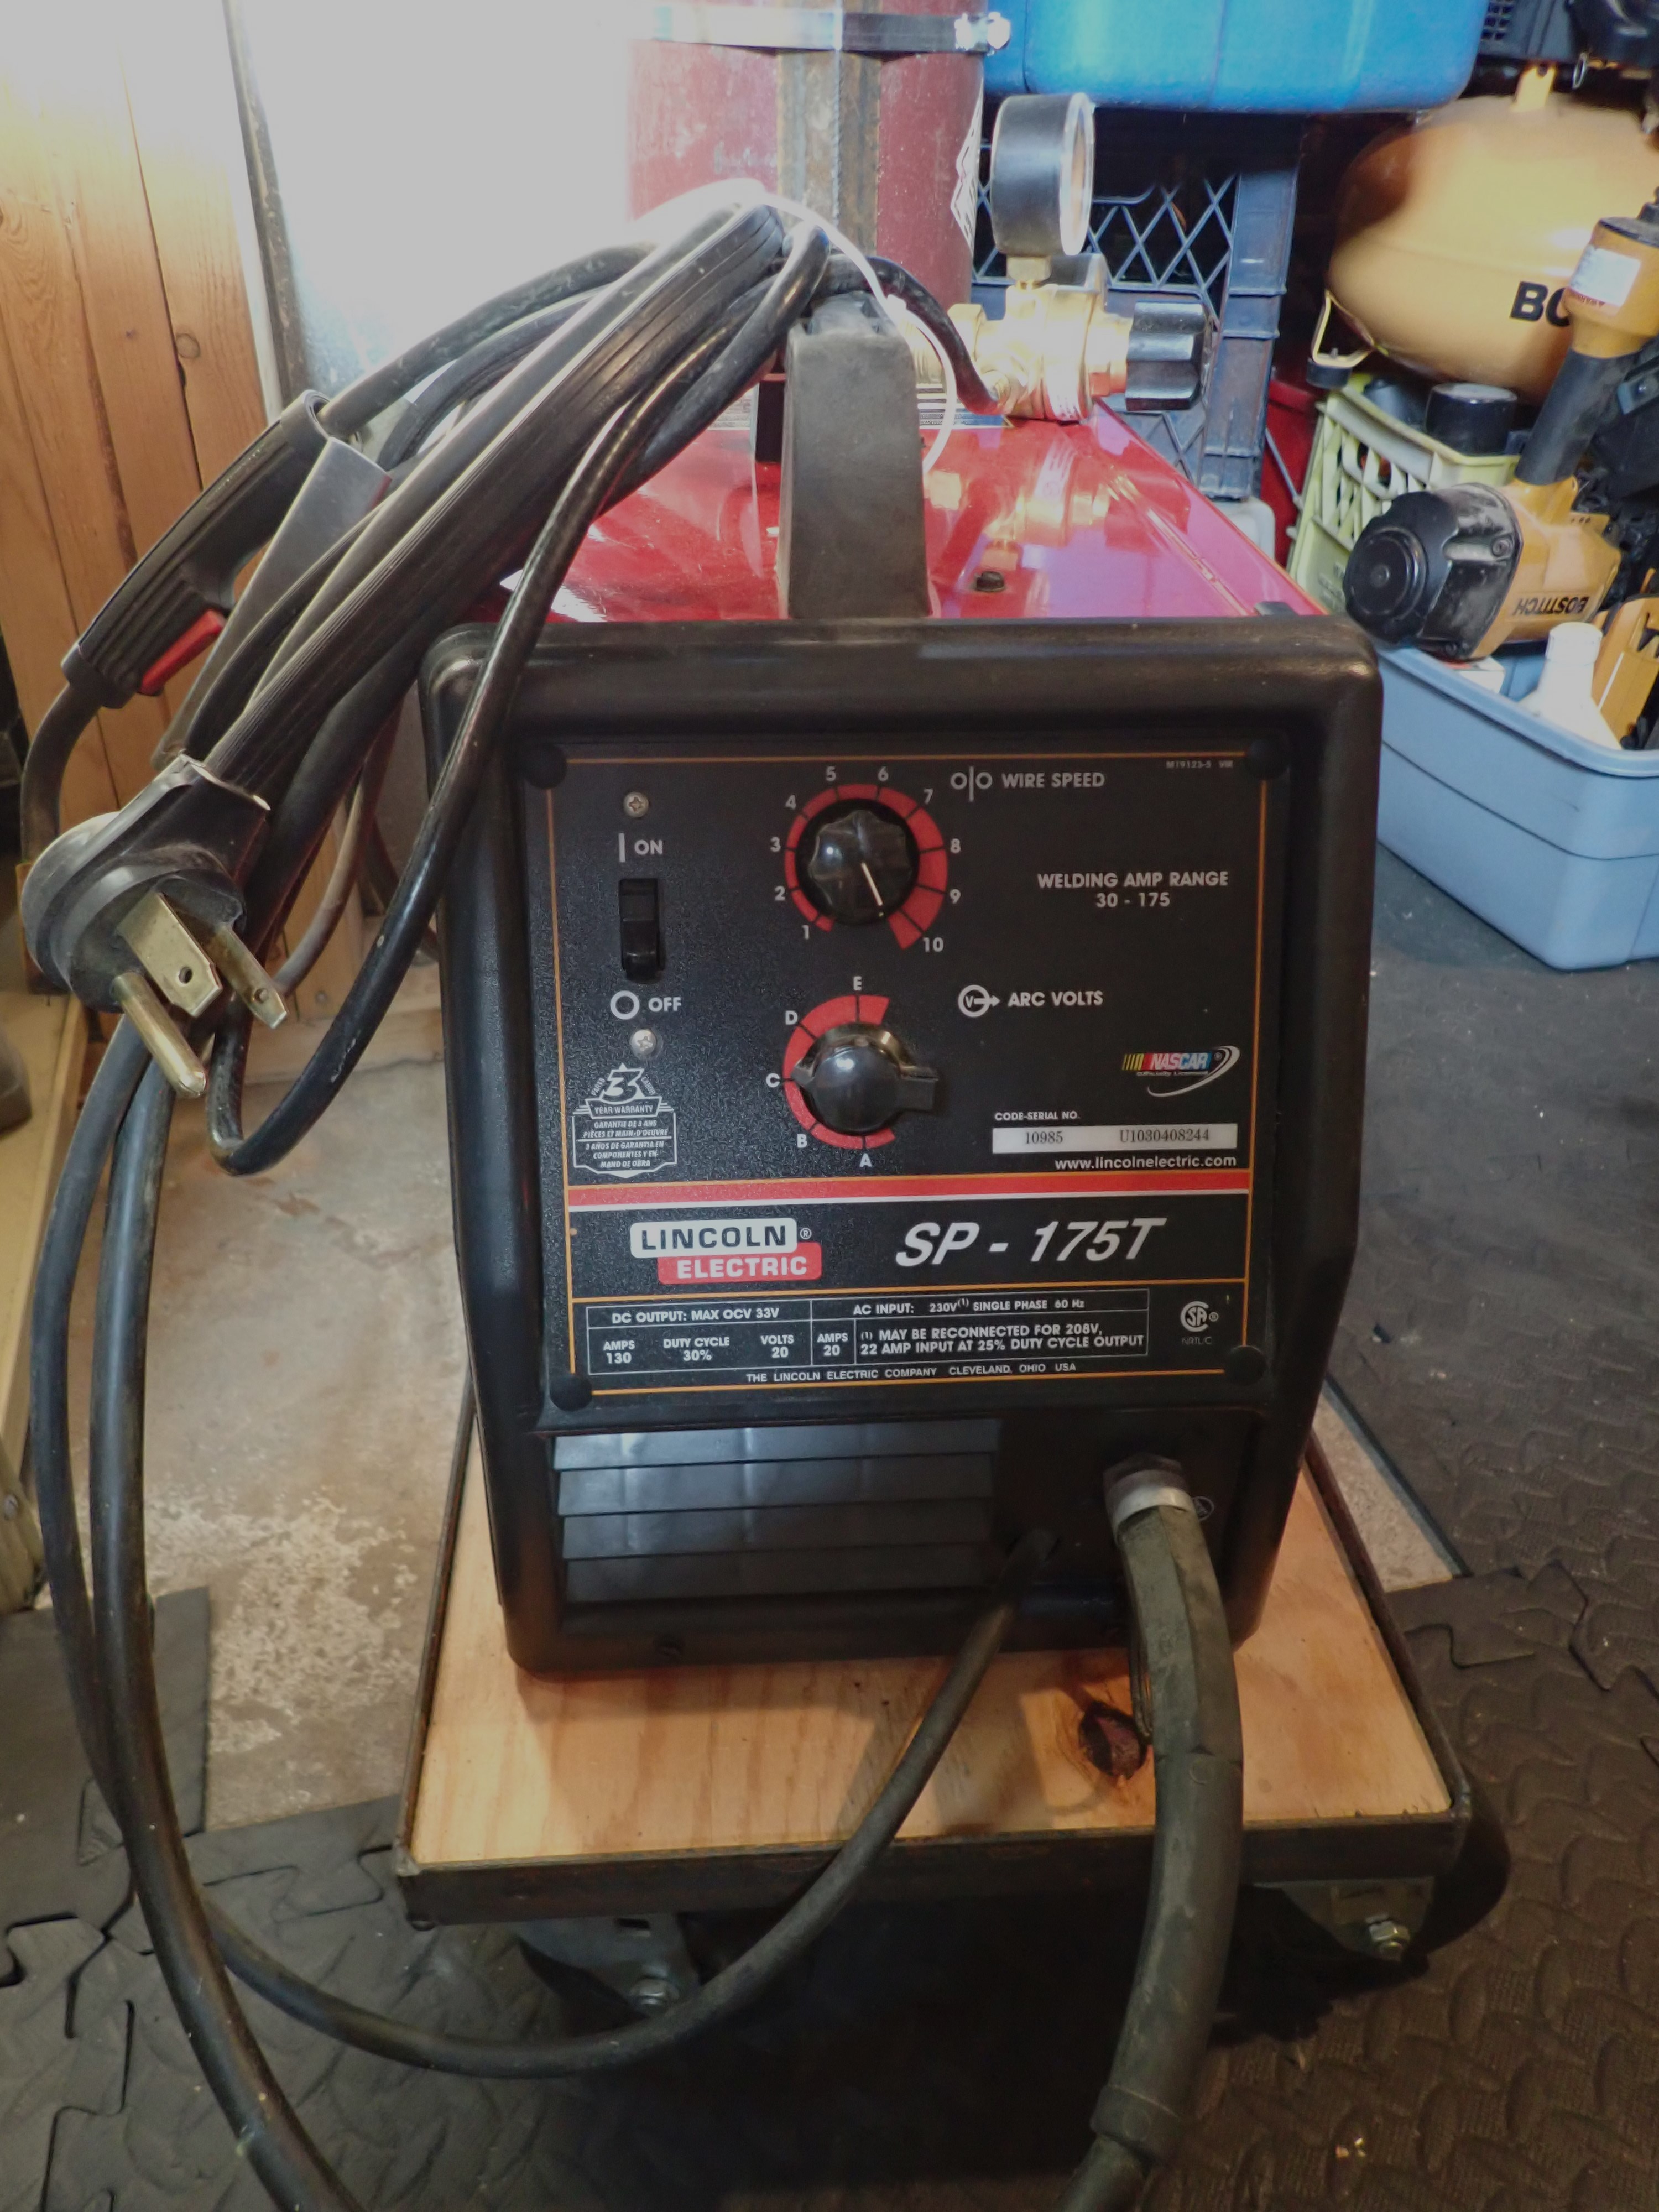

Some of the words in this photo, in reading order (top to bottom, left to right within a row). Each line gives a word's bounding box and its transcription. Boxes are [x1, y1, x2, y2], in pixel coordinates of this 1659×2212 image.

[1513, 596, 1590, 615] BOSTITCH
[826, 766, 837, 781] 5
[878, 767, 889, 781] 6
[1002, 773, 1045, 789] WIRE
[1051, 772, 1105, 788] SPEED
[785, 795, 797, 810] 4
[924, 789, 935, 804] 7
[634, 839, 663, 855] ON
[770, 837, 781, 852] 3
[950, 839, 961, 853] 8
[1037, 873, 1118, 888] WELDING
[1123, 872, 1164, 888] AMP
[1170, 871, 1229, 886] RANGE
[774, 886, 786, 901] 2
[950, 889, 961, 904] 9
[1095, 893, 1118, 907] 30
[1138, 892, 1171, 907] 175
[802, 925, 809, 939] 1
[923, 937, 944, 951] 10
[853, 976, 862, 991] E
[648, 997, 682, 1012] OFF
[1008, 992, 1045, 1007] ARC
[1051, 990, 1104, 1006] VOLTS
[785, 1010, 798, 1025] D
[1150, 1052, 1209, 1070] NASCAR
[591, 1077, 606, 1097] PARTS
[602, 1070, 643, 1103] 3
[640, 1076, 656, 1095] LABOR
[765, 1073, 781, 1088] C
[614, 1105, 654, 1114] WARRANTY
[995, 1111, 1058, 1121] CODE-SERIAL
[1061, 1110, 1082, 1120] NO.
[797, 1134, 808, 1149] B
[1025, 1131, 1063, 1145] 10985
[1119, 1128, 1210, 1143] U1030408244
[655, 1140, 664, 1149] EN
[593, 1151, 642, 1159] COMPONENTES
[859, 1153, 873, 1167] A
[1055, 1155, 1237, 1170] www.lincolnelectric.com
[641, 1225, 786, 1250] LINCOLN
[896, 1222, 980, 1267] SP
[989, 1243, 1009, 1252] -
[1030, 1217, 1167, 1262] 175T
[677, 1256, 807, 1279] ELECTRIC
[853, 1305, 872, 1315] AC
[876, 1303, 914, 1314] INPUT:
[973, 1301, 1011, 1311] SINGLE
[1014, 1300, 1048, 1310] PHASE
[1055, 1300, 1068, 1308] 60
[1072, 1299, 1085, 1308] Hz
[612, 1313, 632, 1324] DC
[635, 1311, 687, 1323] OUTPUT:
[691, 1309, 719, 1321] MAX
[723, 1308, 752, 1319] OCV
[756, 1307, 779, 1318] 33V
[760, 1334, 795, 1345] VOLTS
[817, 1333, 849, 1343] AMPS
[861, 1331, 873, 1341] (1)
[879, 1329, 907, 1340] MAY
[912, 1328, 927, 1339] BE
[931, 1325, 1030, 1339] RECONNECTED
[1034, 1324, 1061, 1335] FOR
[1065, 1323, 1103, 1335] 208V,
[603, 1340, 635, 1351] AMPS
[664, 1338, 691, 1348] DUTY
[694, 1337, 730, 1347] CYCLE
[823, 1344, 841, 1356] 20
[860, 1343, 878, 1355] 22
[881, 1342, 912, 1354] AMP
[915, 1340, 954, 1353] INPUT
[957, 1340, 973, 1352] AT
[978, 1339, 1006, 1351] 25%
[1010, 1338, 1043, 1350] DUTY
[1047, 1336, 1089, 1348] CYCLE
[1093, 1335, 1144, 1347] OUTPUT
[606, 1352, 632, 1364] 130
[683, 1349, 712, 1361] 30%
[771, 1347, 789, 1358] 20
[746, 1374, 767, 1383] THE
[774, 1371, 820, 1381] LINCOLN
[827, 1369, 879, 1380] ELECTRIC
[885, 1368, 937, 1378] COMPANY
[1019, 1364, 1046, 1373] OHIO
[1054, 1363, 1077, 1371] USA
